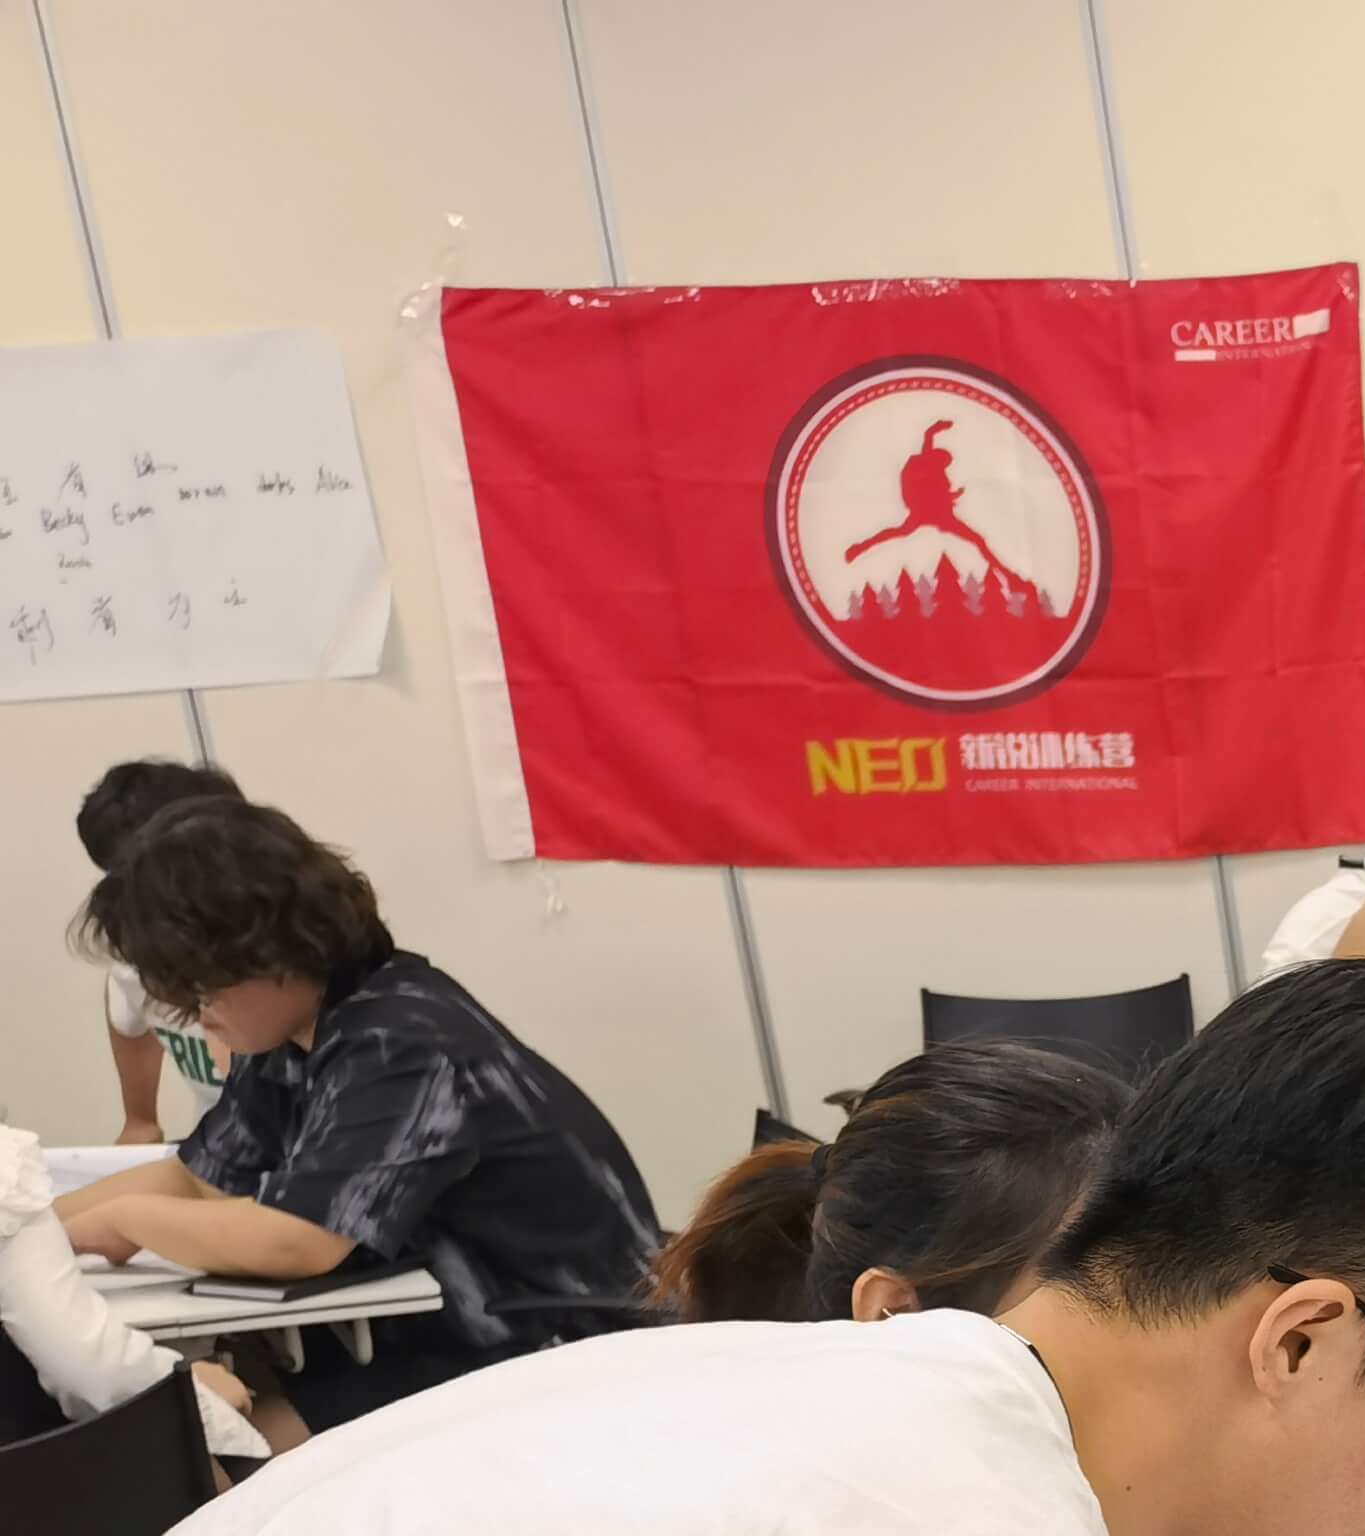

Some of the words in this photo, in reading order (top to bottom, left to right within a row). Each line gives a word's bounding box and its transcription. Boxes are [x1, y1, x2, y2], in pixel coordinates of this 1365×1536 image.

[1170, 317, 1292, 347] CAREER
[806, 736, 947, 797] NEO
[965, 779, 1020, 793] CAREER
[1025, 777, 1137, 792] INTERNATIONAL
